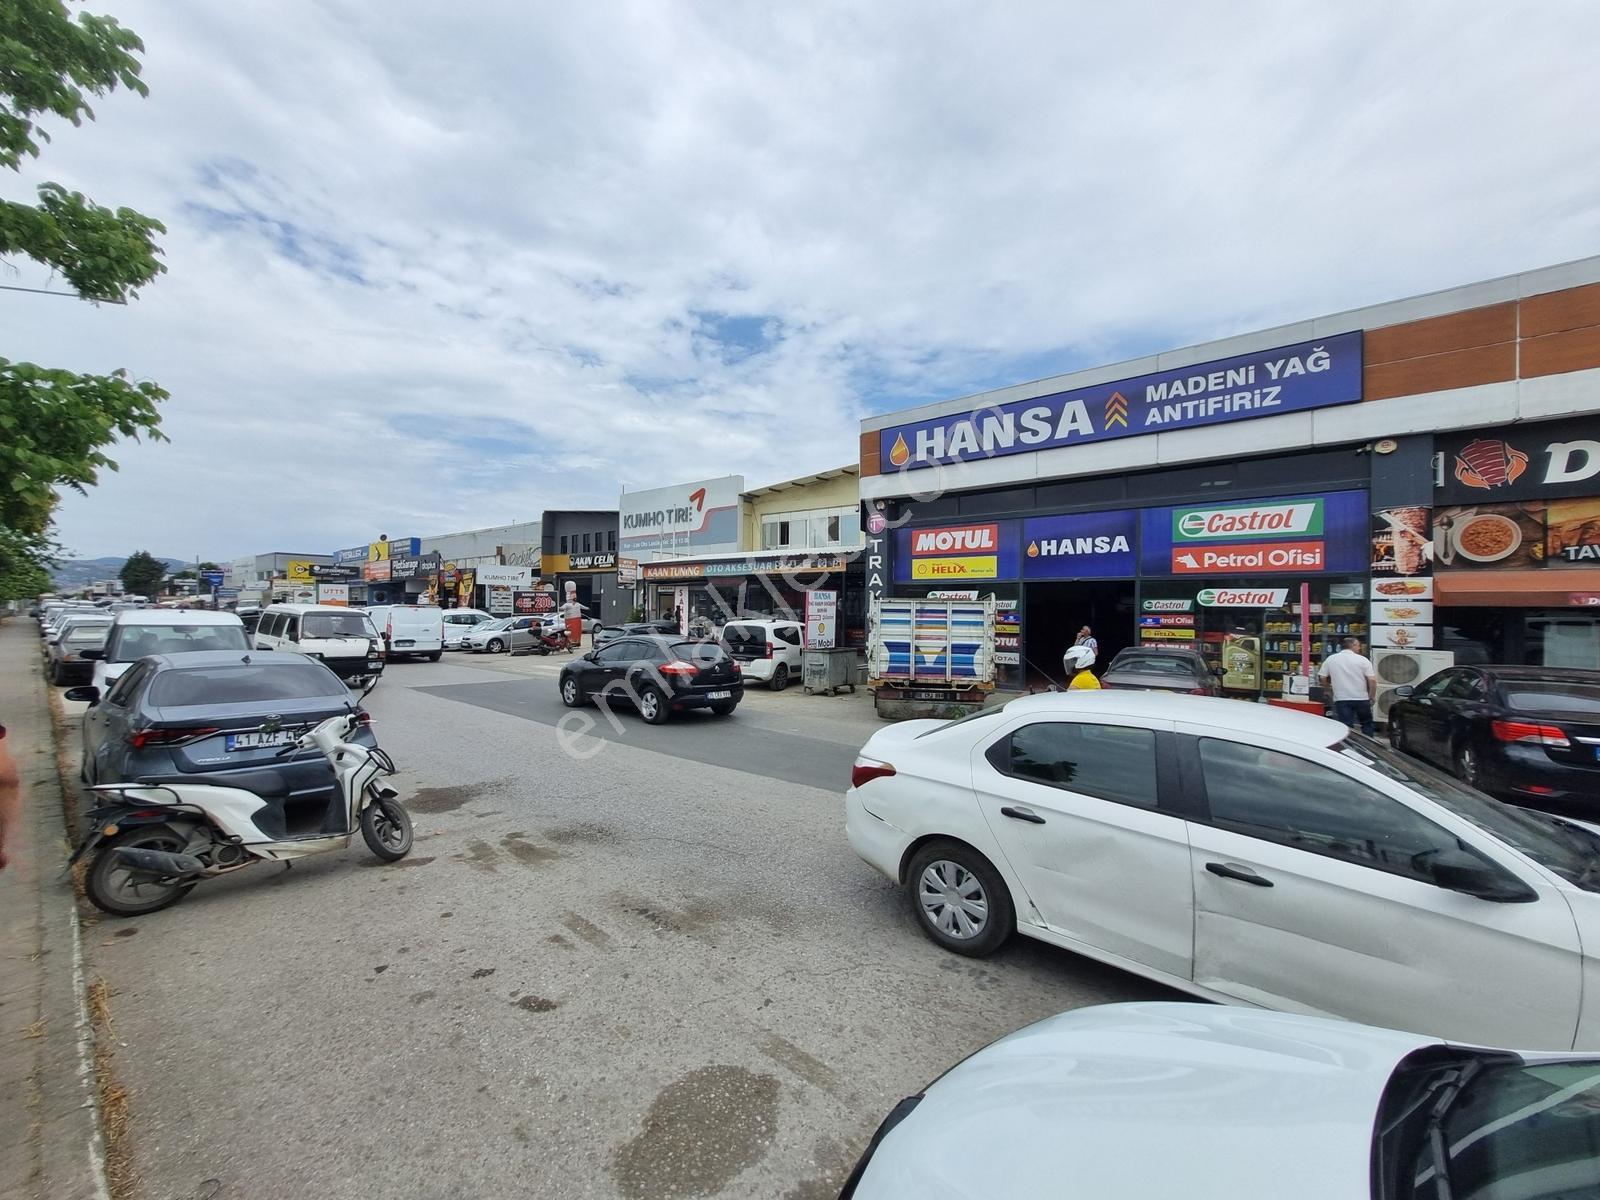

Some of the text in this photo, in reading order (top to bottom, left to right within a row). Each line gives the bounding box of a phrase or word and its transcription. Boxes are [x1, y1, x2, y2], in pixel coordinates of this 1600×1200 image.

[1264, 346, 1331, 380] YAĞ
[915, 399, 1095, 462] HANSA
[623, 506, 692, 529] KUMHO TIRE
[1207, 508, 1294, 533] Castrol
[915, 529, 993, 551] MOTUL
[1041, 535, 1130, 556] HANSA
[574, 556, 593, 566] AKIN
[1204, 548, 1321, 568] Petrol Ofisi
[647, 567, 669, 577] KAAN
[706, 564, 723, 573] OTO
[725, 561, 772, 572] AKSESUAR
[932, 565, 968, 575] HELIX
[534, 597, 552, 608] 200
[1154, 600, 1185, 609] Castrol
[1215, 590, 1274, 605] Castrol
[817, 638, 833, 648] Mobil
[995, 638, 1018, 646] OTUL
[236, 735, 251, 746] 41
[258, 732, 280, 744] AZF
